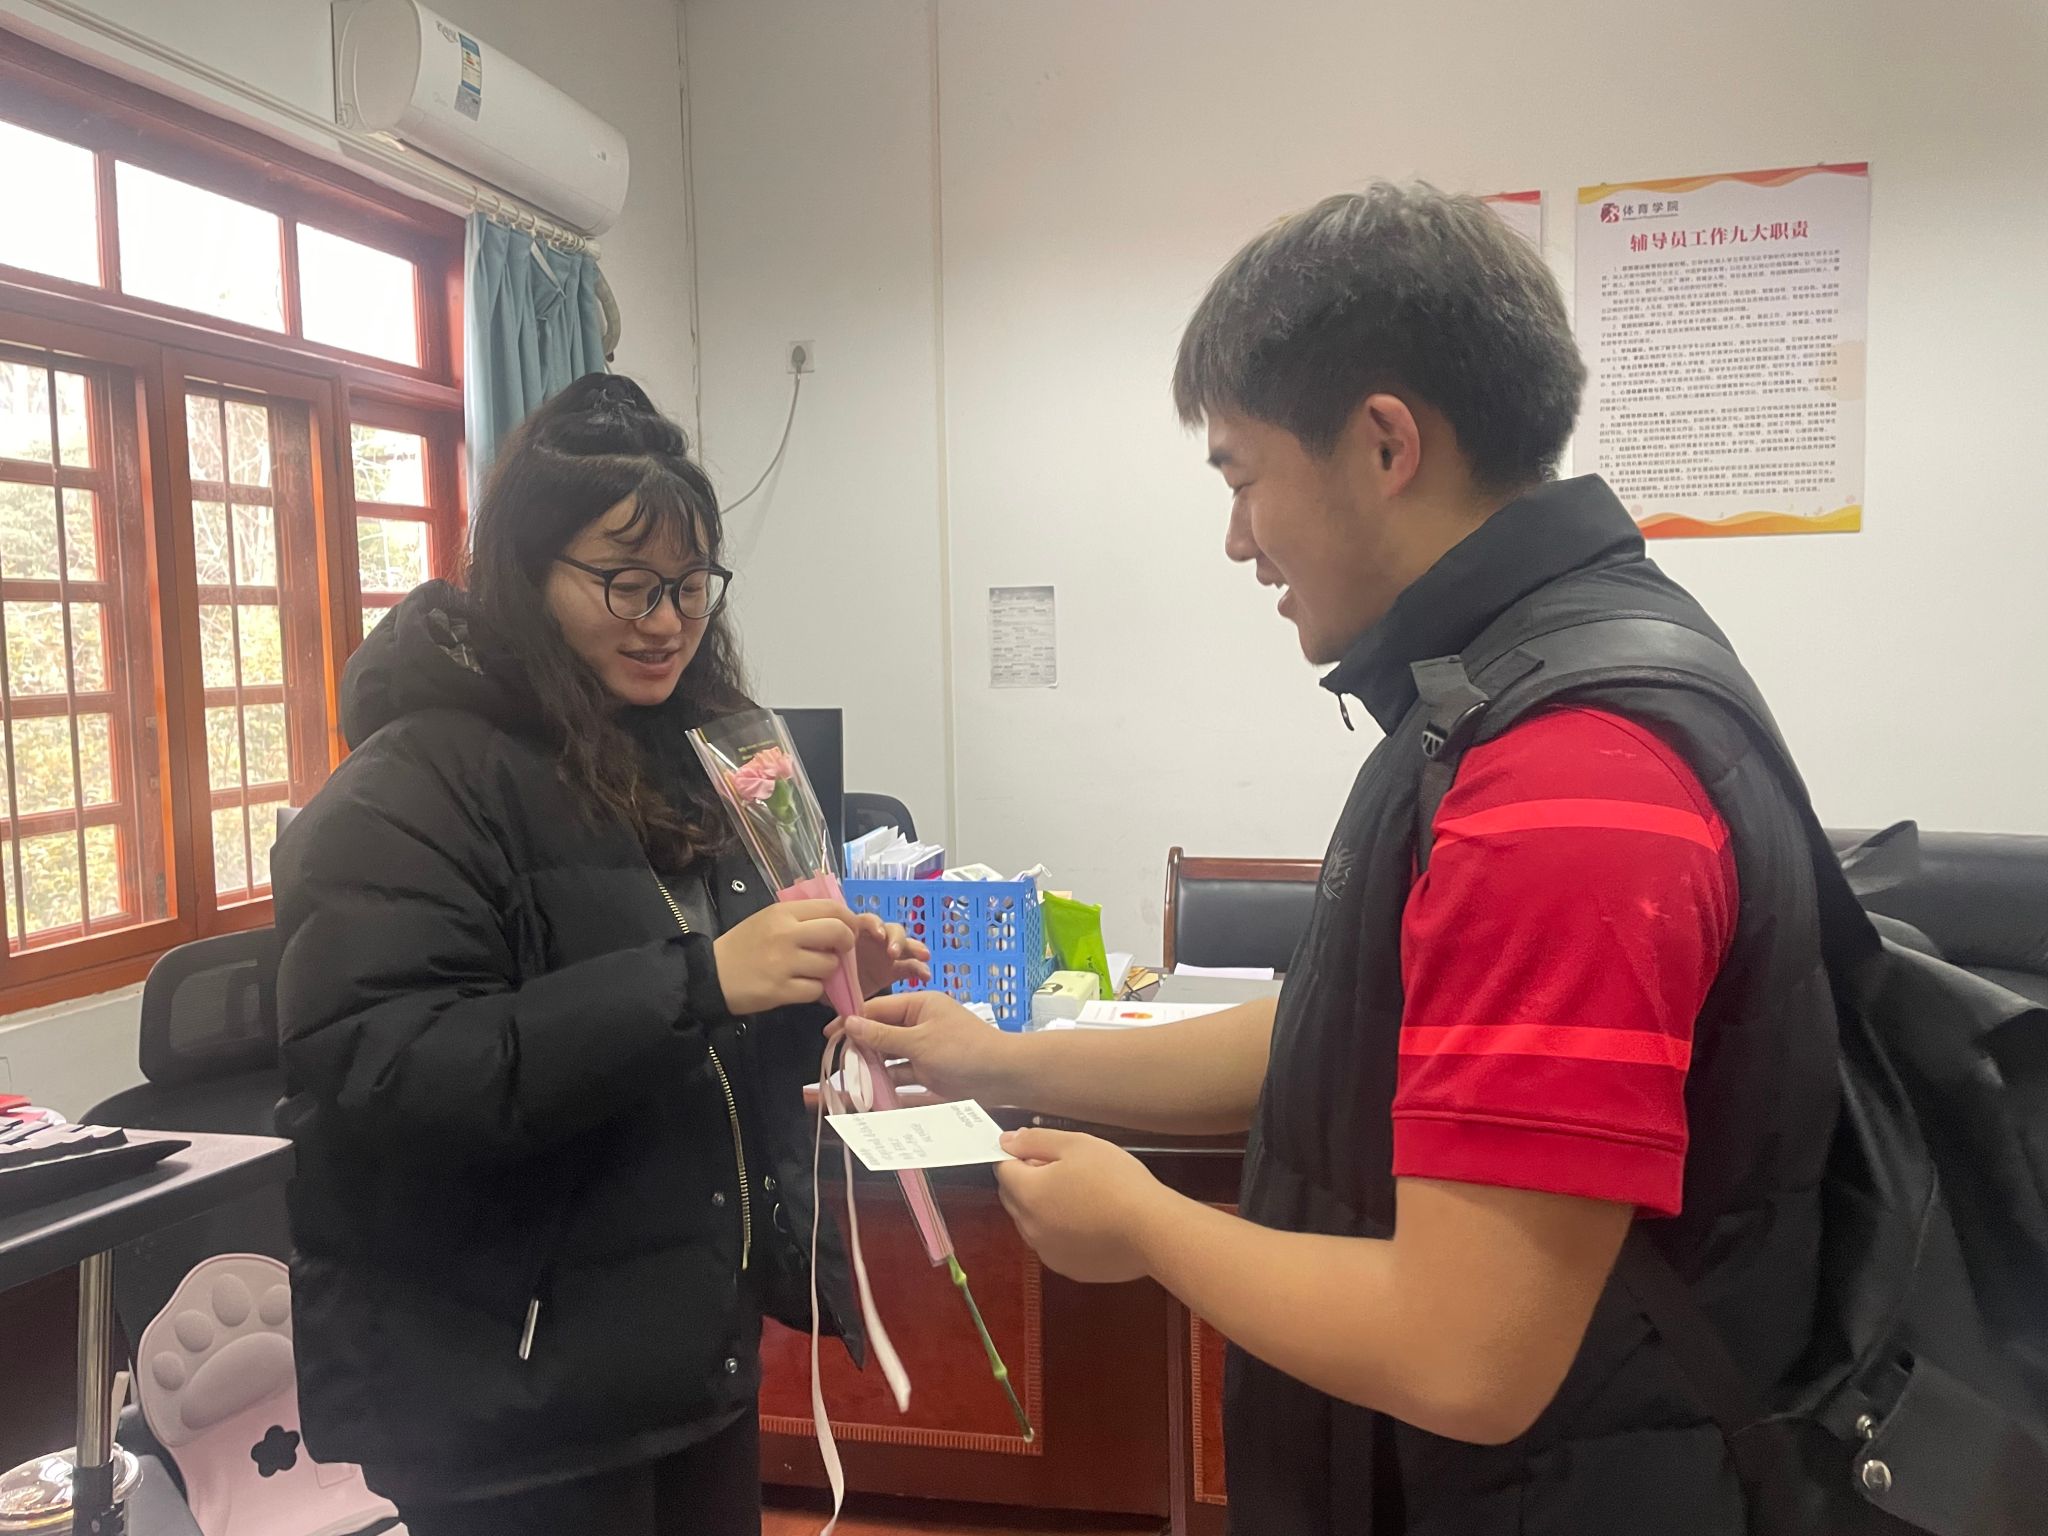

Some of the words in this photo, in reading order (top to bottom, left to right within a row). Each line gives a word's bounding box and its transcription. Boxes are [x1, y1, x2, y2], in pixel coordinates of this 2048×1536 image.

[1623, 200, 1679, 215] 体育学院
[1630, 220, 1809, 253] 辅导员工作九大职责
